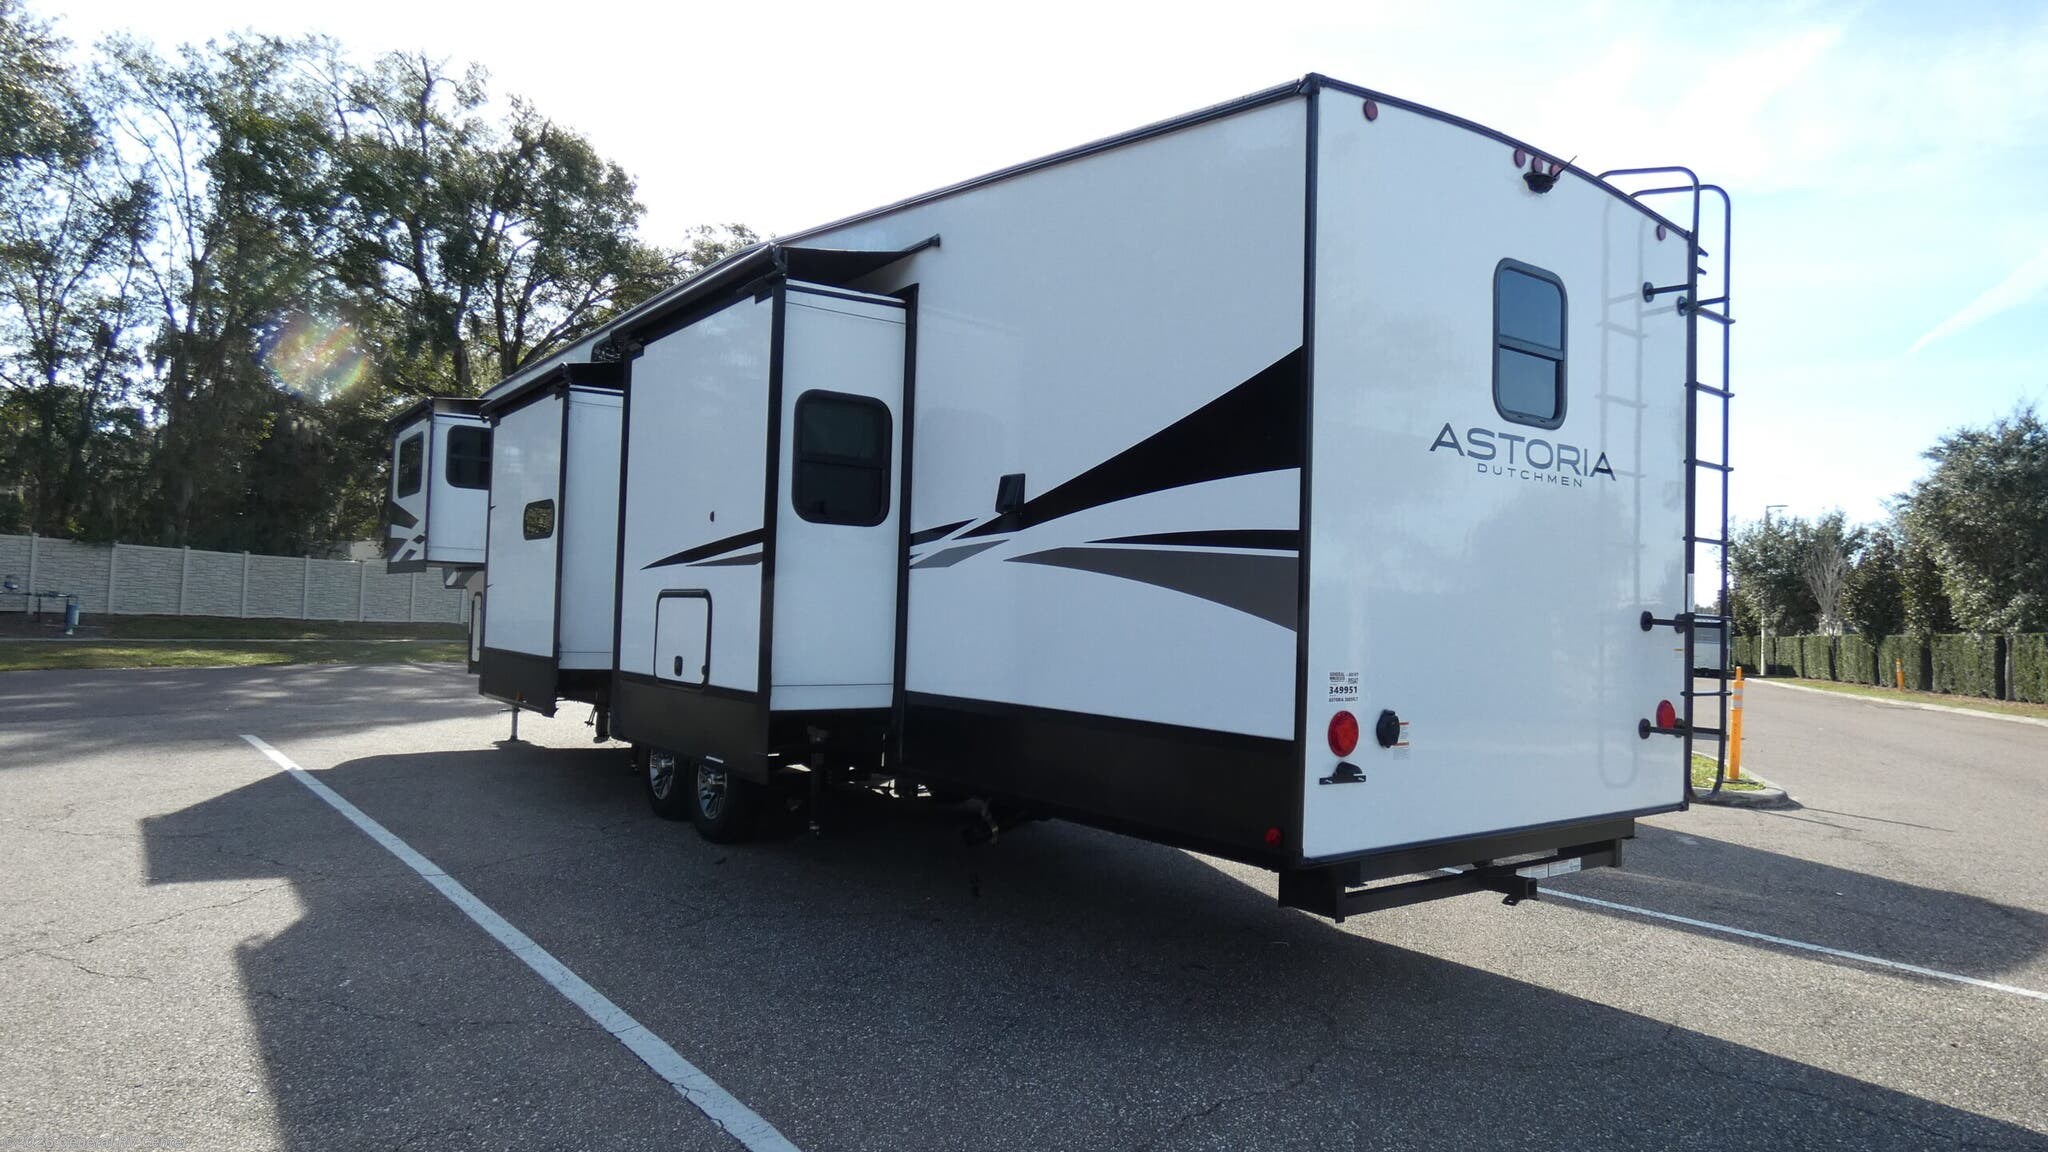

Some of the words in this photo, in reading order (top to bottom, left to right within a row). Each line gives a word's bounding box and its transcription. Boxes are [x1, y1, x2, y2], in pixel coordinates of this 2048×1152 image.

[1429, 422, 1616, 481] ASTORIA
[1477, 463, 1583, 488] DUTCHMEN
[1329, 686, 1358, 694] 349951
